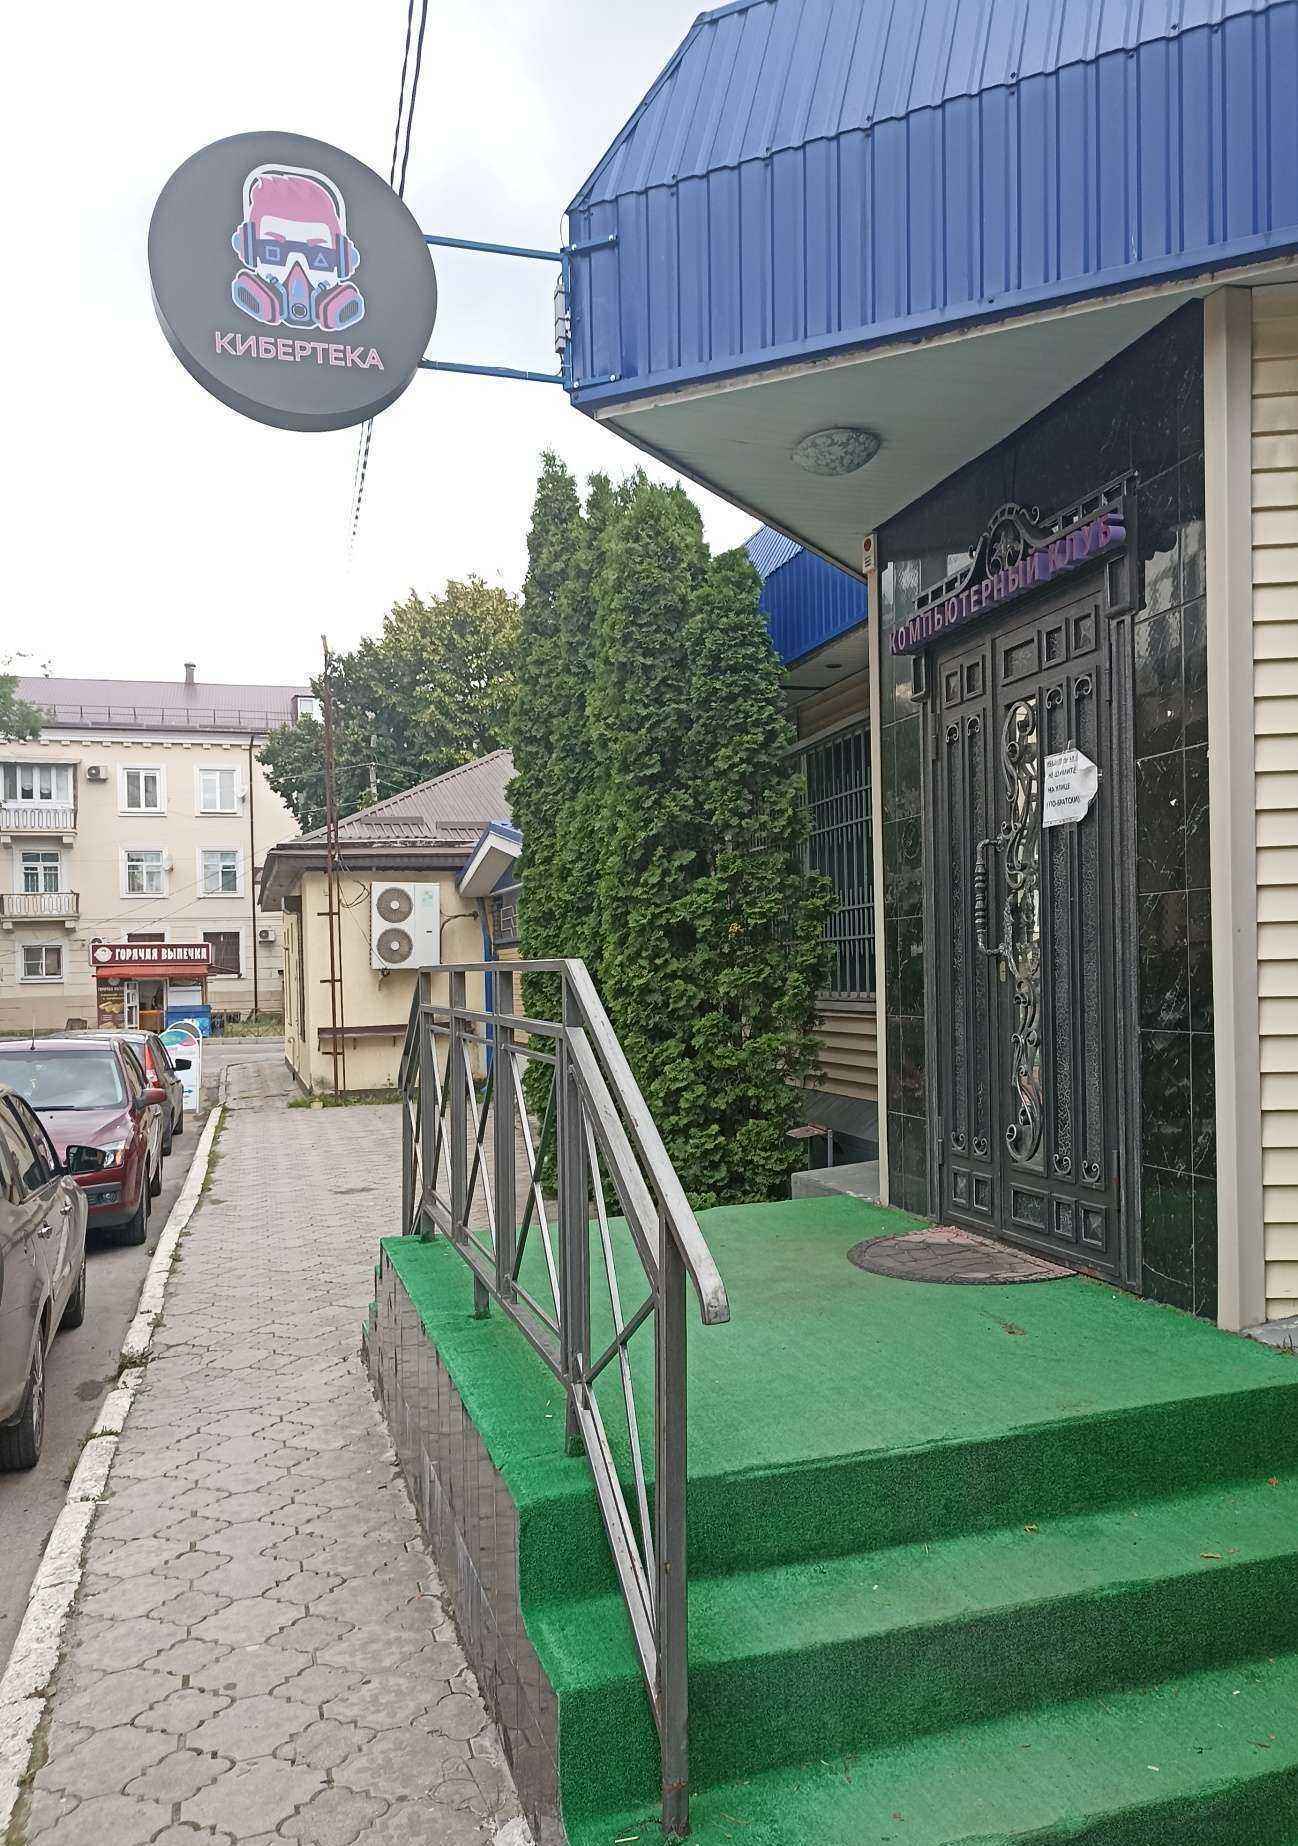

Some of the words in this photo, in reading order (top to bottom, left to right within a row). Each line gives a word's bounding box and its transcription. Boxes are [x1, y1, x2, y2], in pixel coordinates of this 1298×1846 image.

[214, 331, 385, 371] КИБЕРТЕКА
[889, 545, 1041, 655] КОМПЬЮТЕРНЫЙ
[1048, 512, 1122, 571] КЛУБ
[115, 948, 158, 960] ГОРЯЧАЯ
[161, 947, 207, 960] ВЫПЕЧКА
